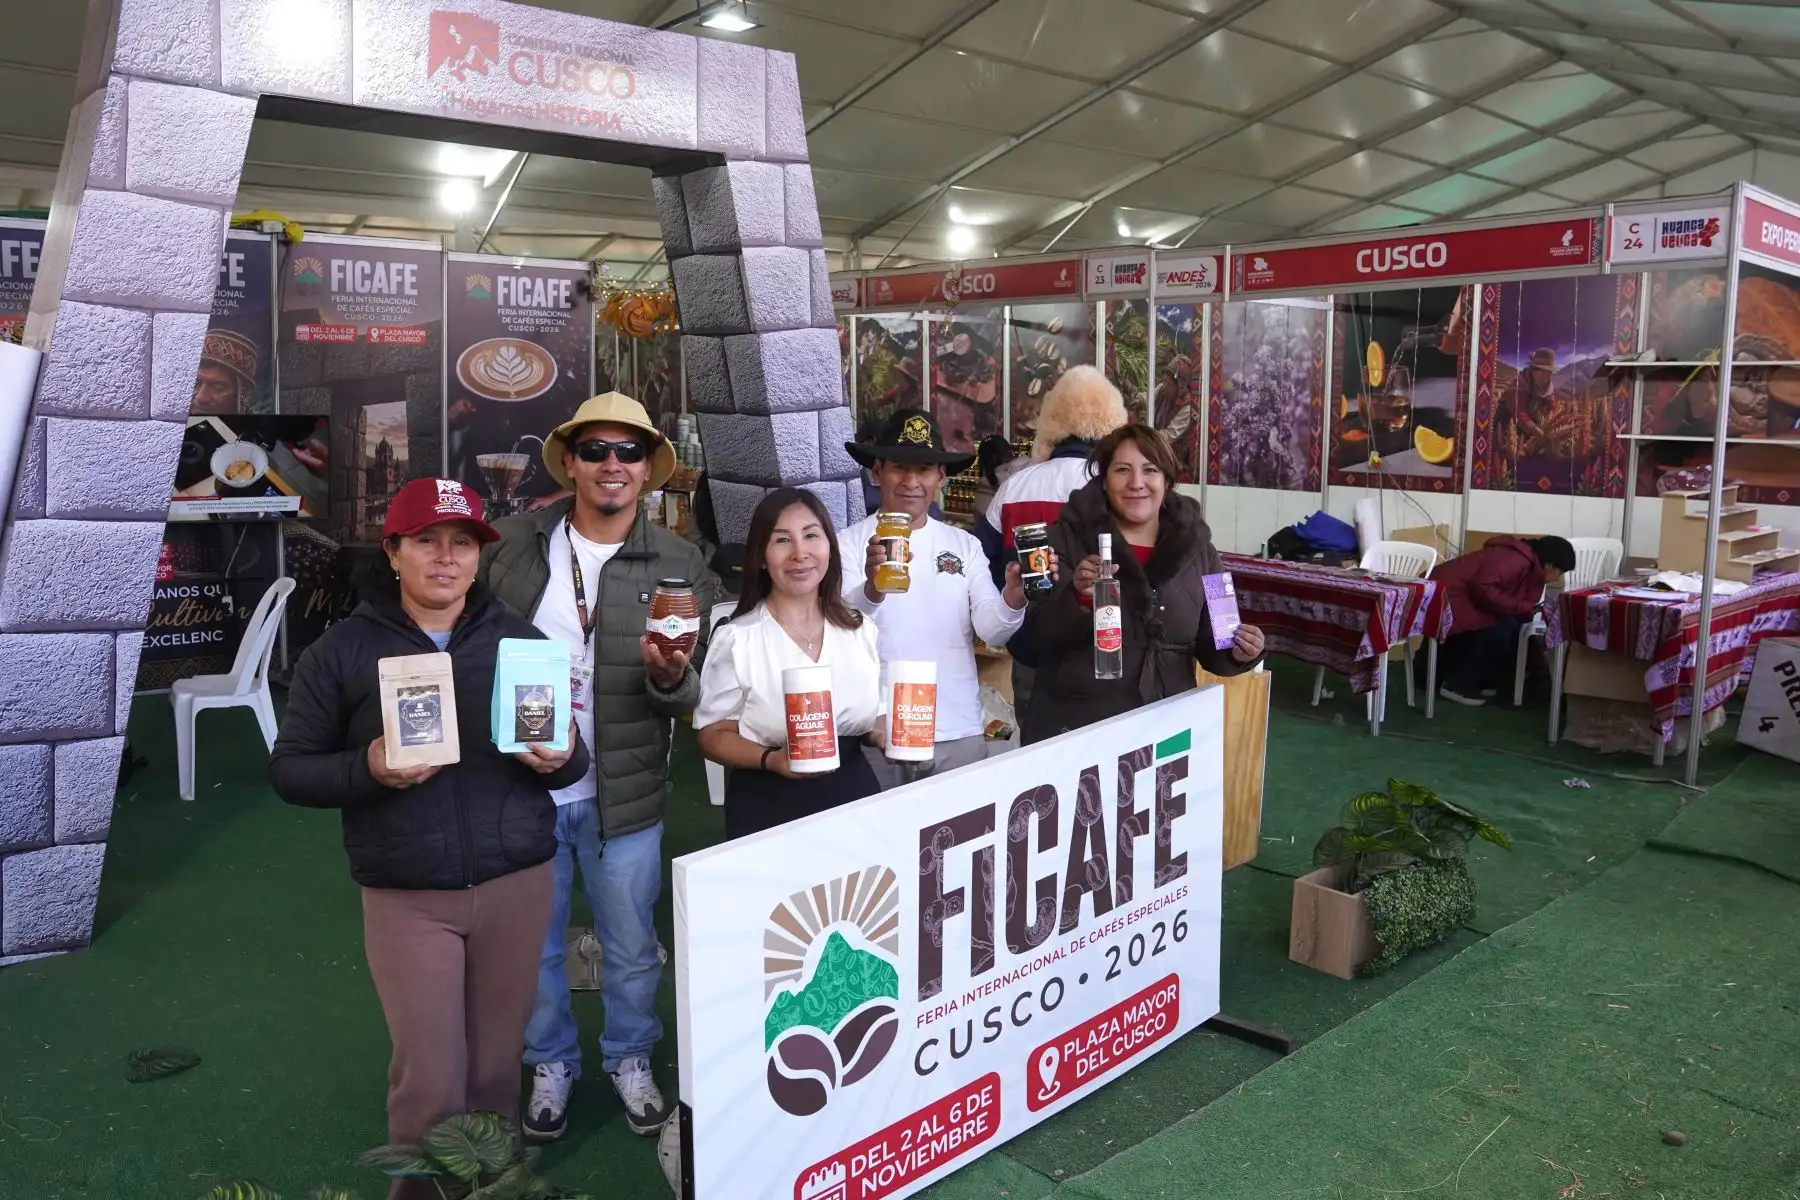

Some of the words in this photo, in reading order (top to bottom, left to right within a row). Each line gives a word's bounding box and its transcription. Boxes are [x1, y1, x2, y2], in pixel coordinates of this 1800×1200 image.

[508, 50, 636, 100] CUSCO
[1629, 222, 1640, 234] C
[1761, 221, 1783, 247] EXPO
[1623, 238, 1643, 250] 24
[1356, 241, 1447, 273] CUSCO
[1097, 265, 1103, 273] C
[330, 259, 418, 295] FICAFE
[1095, 276, 1105, 284] 23
[1166, 270, 1206, 283] ANDES
[497, 275, 571, 309] FICAFE
[331, 295, 354, 303] FERIA
[356, 296, 418, 306] INTERNACIONAL
[349, 304, 375, 313] CAFÉS
[376, 306, 413, 314] ESPECIAL
[497, 308, 517, 316] FERIA
[518, 309, 571, 318] INTERNACIONAL
[344, 313, 375, 321] CUSCO
[381, 314, 404, 322] 2026
[513, 316, 534, 325] CAFÉS
[536, 318, 566, 326] ESPECIAL
[313, 333, 355, 341] NOVIEMBRE
[380, 329, 402, 337] PLAZA
[439, 497, 467, 505] CUSCO
[789, 711, 830, 722] COLÁGENO
[795, 721, 825, 730] AGUAJE
[917, 1000, 958, 1029] FERIA
[962, 949, 1067, 1006] INTERNACIONAL
[1070, 933, 1087, 954] DE
[1089, 917, 1125, 948] CAFÉS
[1126, 885, 1189, 928] ESPECIALES
[914, 976, 1065, 1076] CUSCO
[1106, 910, 1189, 982] 2026
[1063, 1018, 1120, 1062] PLAZA
[1123, 984, 1177, 1025] MAYOR
[1076, 1051, 1109, 1078] DEL
[1112, 1012, 1166, 1054] CUSCO
[851, 1141, 895, 1178] DEL
[900, 1130, 912, 1151] 2
[917, 1117, 944, 1144] AL
[949, 1102, 961, 1123] 6
[967, 1085, 993, 1115] DE
[862, 1112, 988, 1198] NOVIEMBRE
